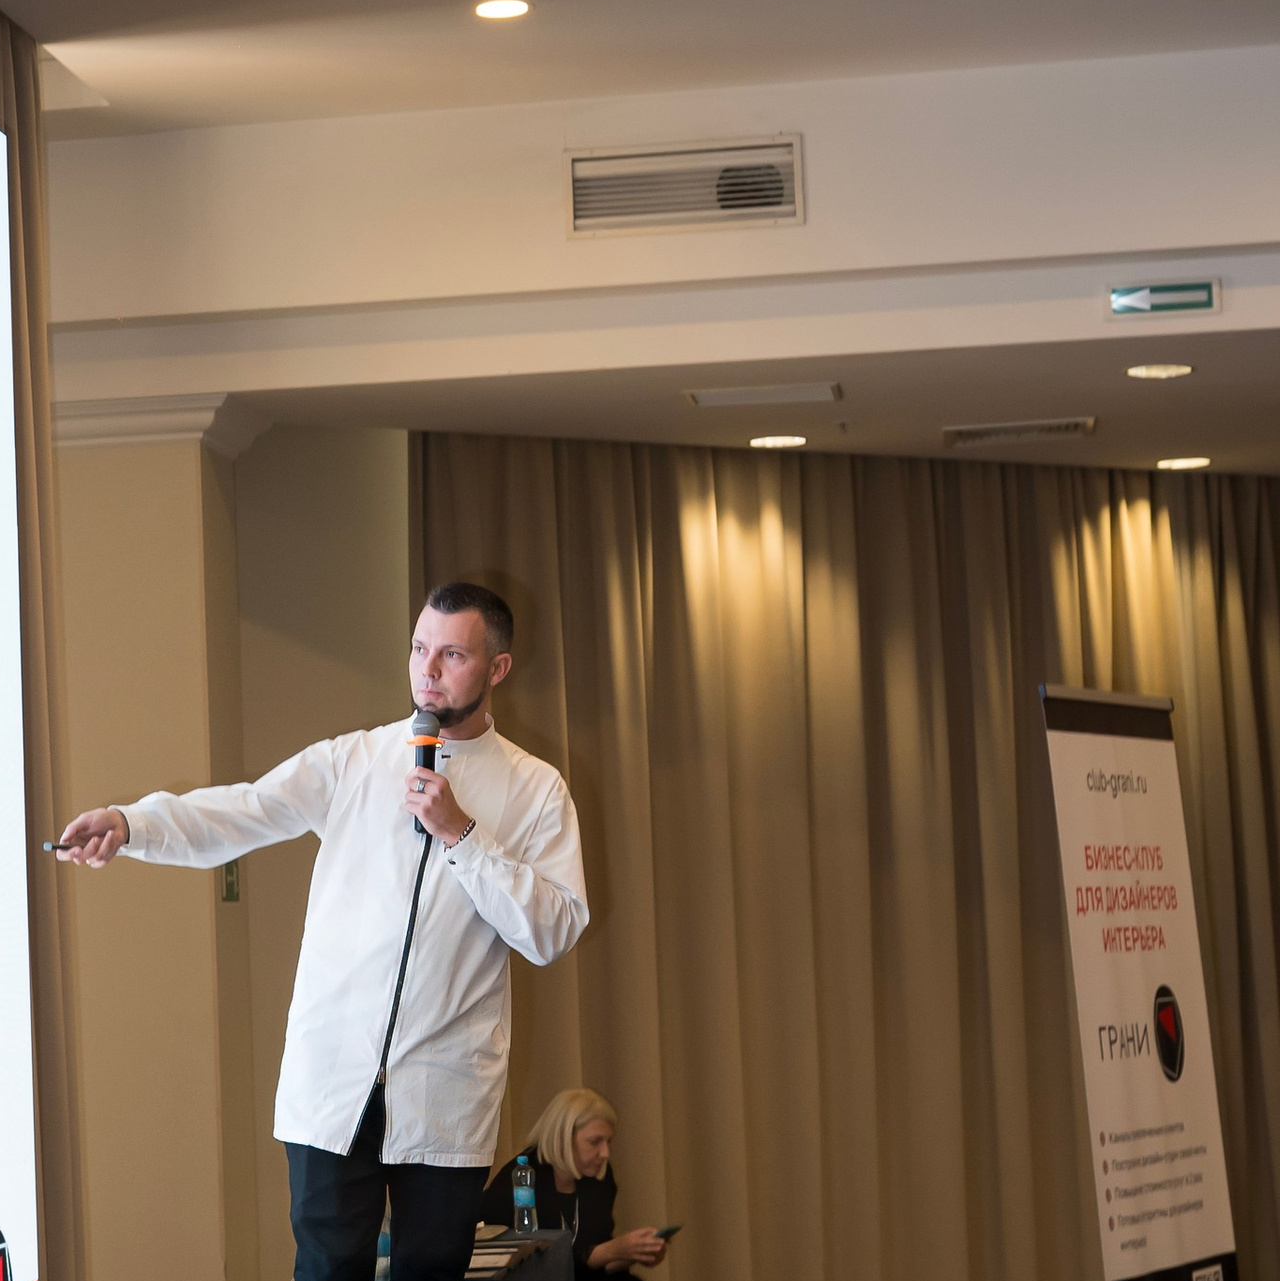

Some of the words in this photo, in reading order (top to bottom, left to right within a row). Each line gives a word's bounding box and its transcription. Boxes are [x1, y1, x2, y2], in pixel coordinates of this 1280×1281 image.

[1087, 769, 1147, 799] club-grani.ru
[1084, 844, 1163, 871] БИЗНЕС-КЛУБ
[1076, 886, 1103, 916] ДЛЯ
[1106, 880, 1178, 914] ДИЗАЙНЕРОВ
[1102, 926, 1166, 953] ИНТЕРЬЕРА
[1098, 1022, 1150, 1062] ГРАНИ
